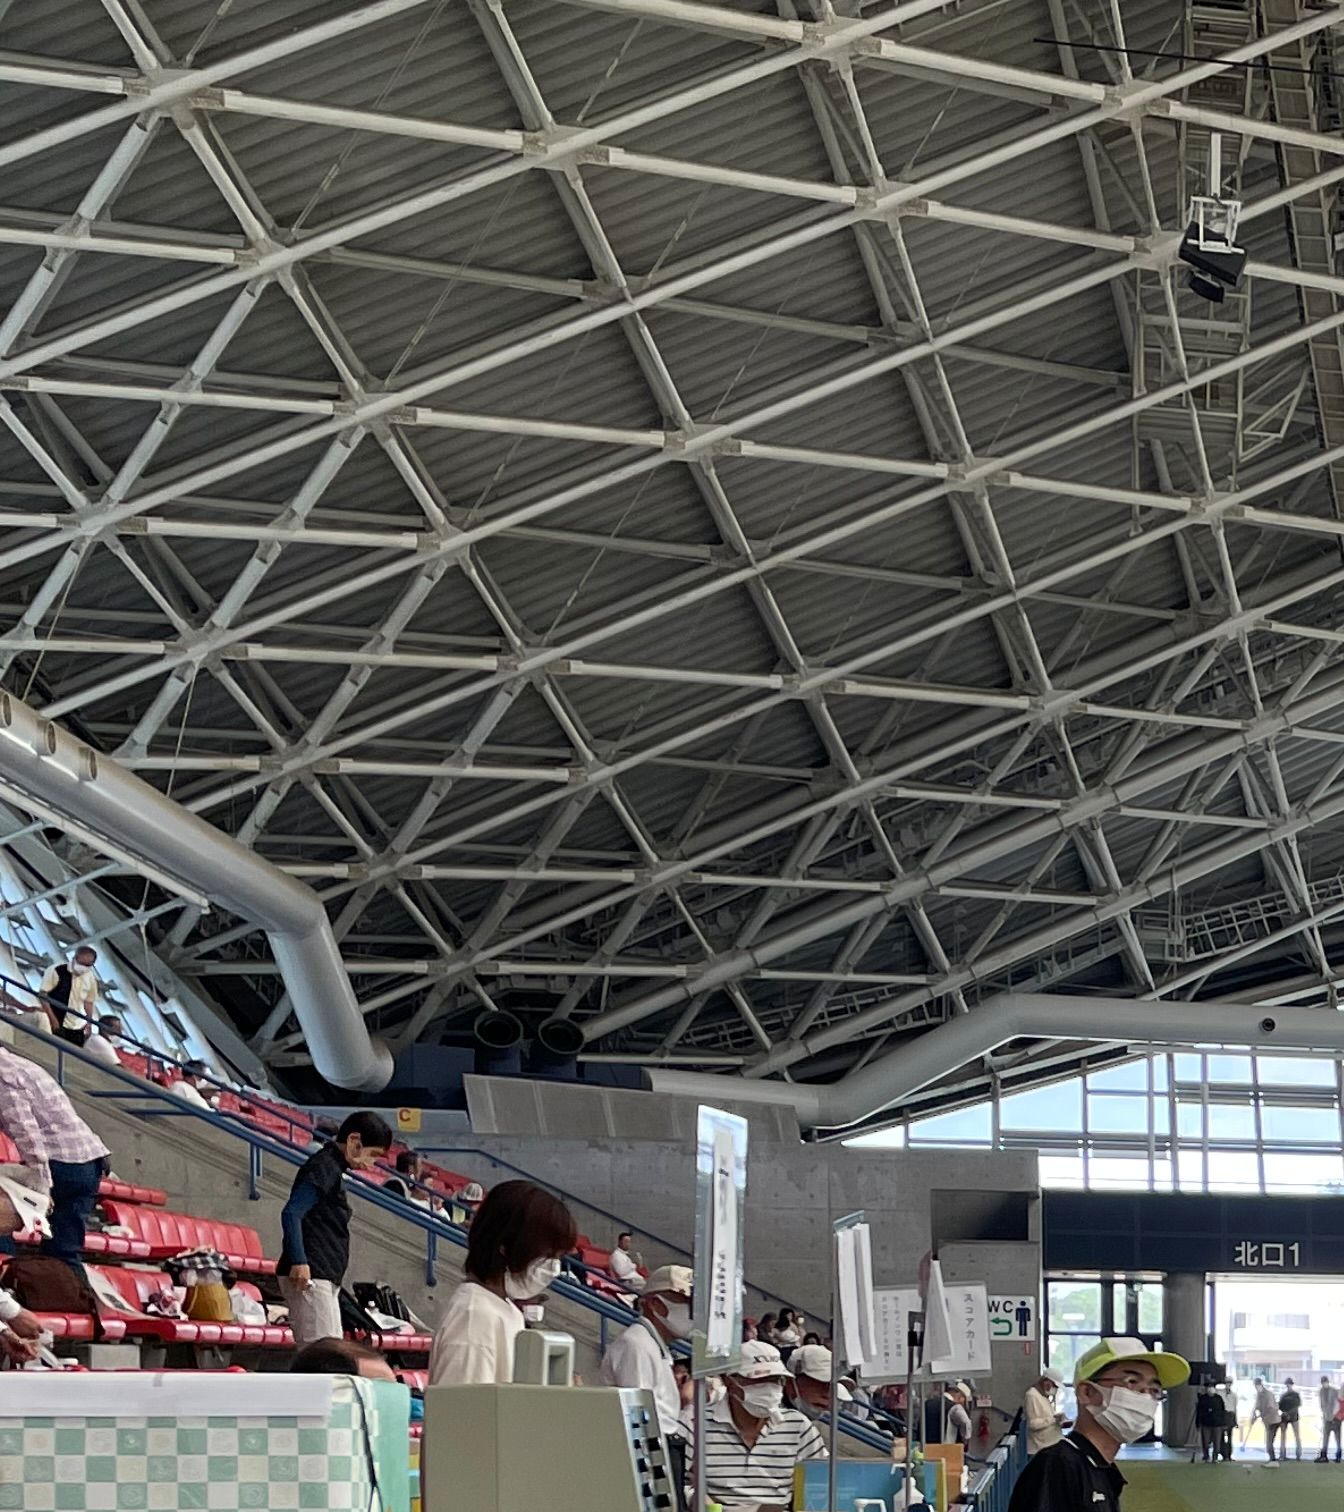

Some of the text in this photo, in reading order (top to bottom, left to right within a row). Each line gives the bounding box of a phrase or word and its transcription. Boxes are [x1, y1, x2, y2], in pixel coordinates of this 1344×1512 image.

[399, 1109, 411, 1122] C
[1234, 1241, 1299, 1267] 北口1
[987, 1300, 1014, 1313] WC
[963, 1293, 976, 1361] スコアカード
